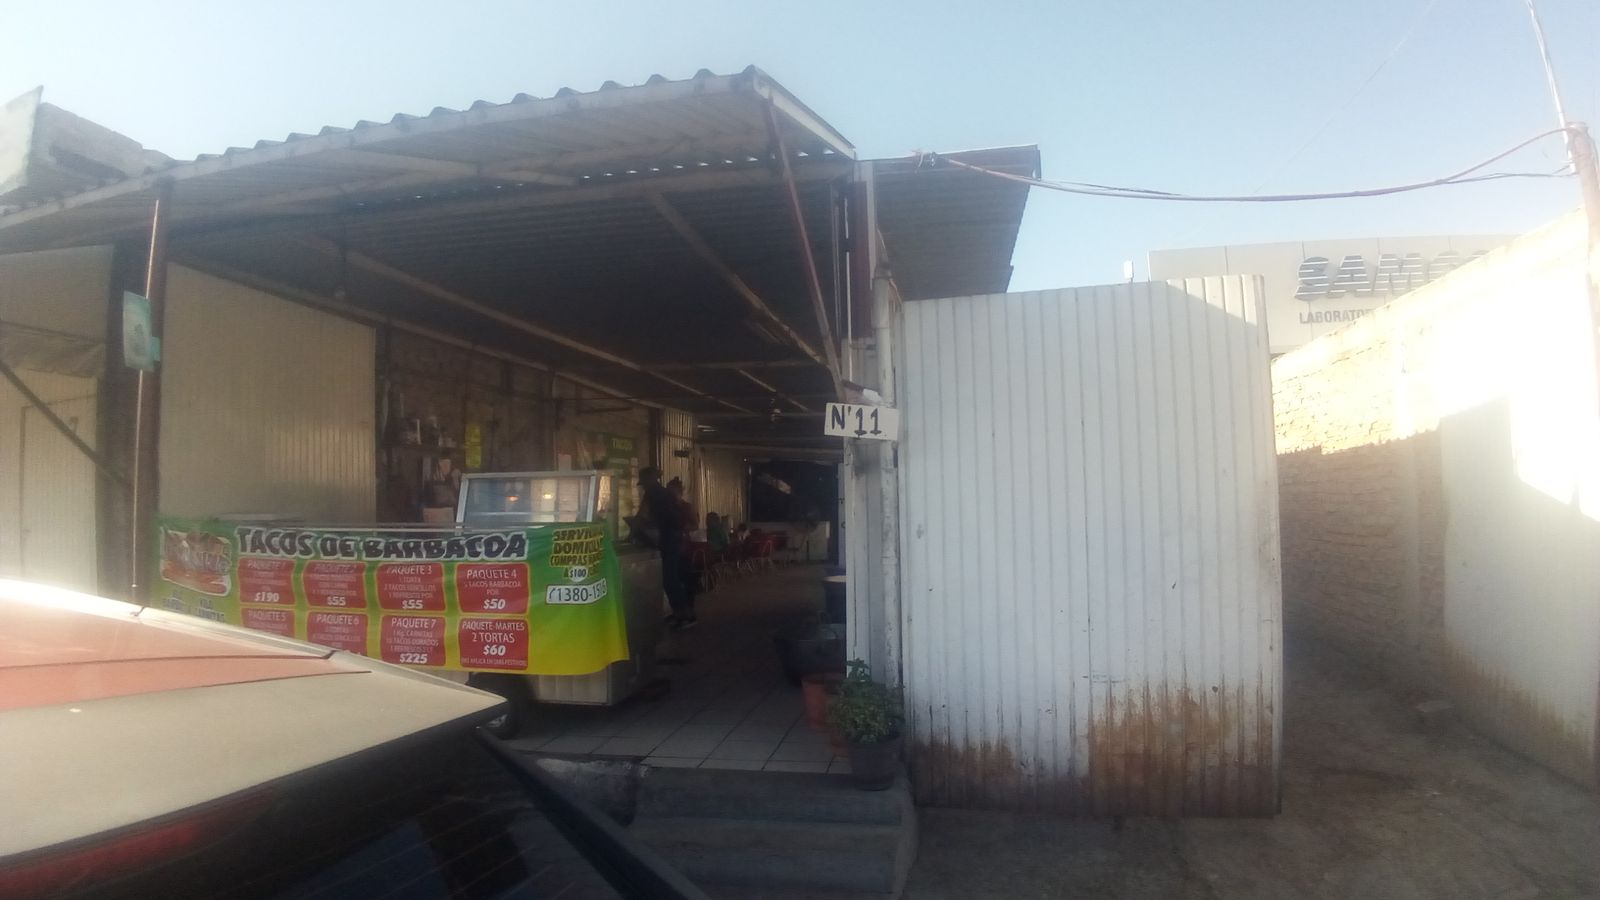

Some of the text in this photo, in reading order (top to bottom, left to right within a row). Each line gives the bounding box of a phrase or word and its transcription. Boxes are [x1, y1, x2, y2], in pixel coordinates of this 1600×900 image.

[1294, 251, 1490, 301] SAM
[552, 527, 604, 541] SERVI
[235, 527, 528, 560] TACOS DE BARBACOA
[550, 555, 587, 566] COMPRAS
[386, 565, 432, 575] PAQUETE 3
[466, 569, 517, 579] PAQUETE 4
[569, 568, 587, 578] $100
[254, 592, 280, 603] $190
[327, 596, 347, 606] $55
[402, 600, 424, 609] $55
[483, 599, 506, 610] $50
[316, 614, 353, 625] PAQUETE
[391, 617, 437, 629] PAQUETE 7
[472, 632, 515, 643] 2 TORTAS
[483, 645, 506, 656] $60
[400, 653, 428, 664] $225
